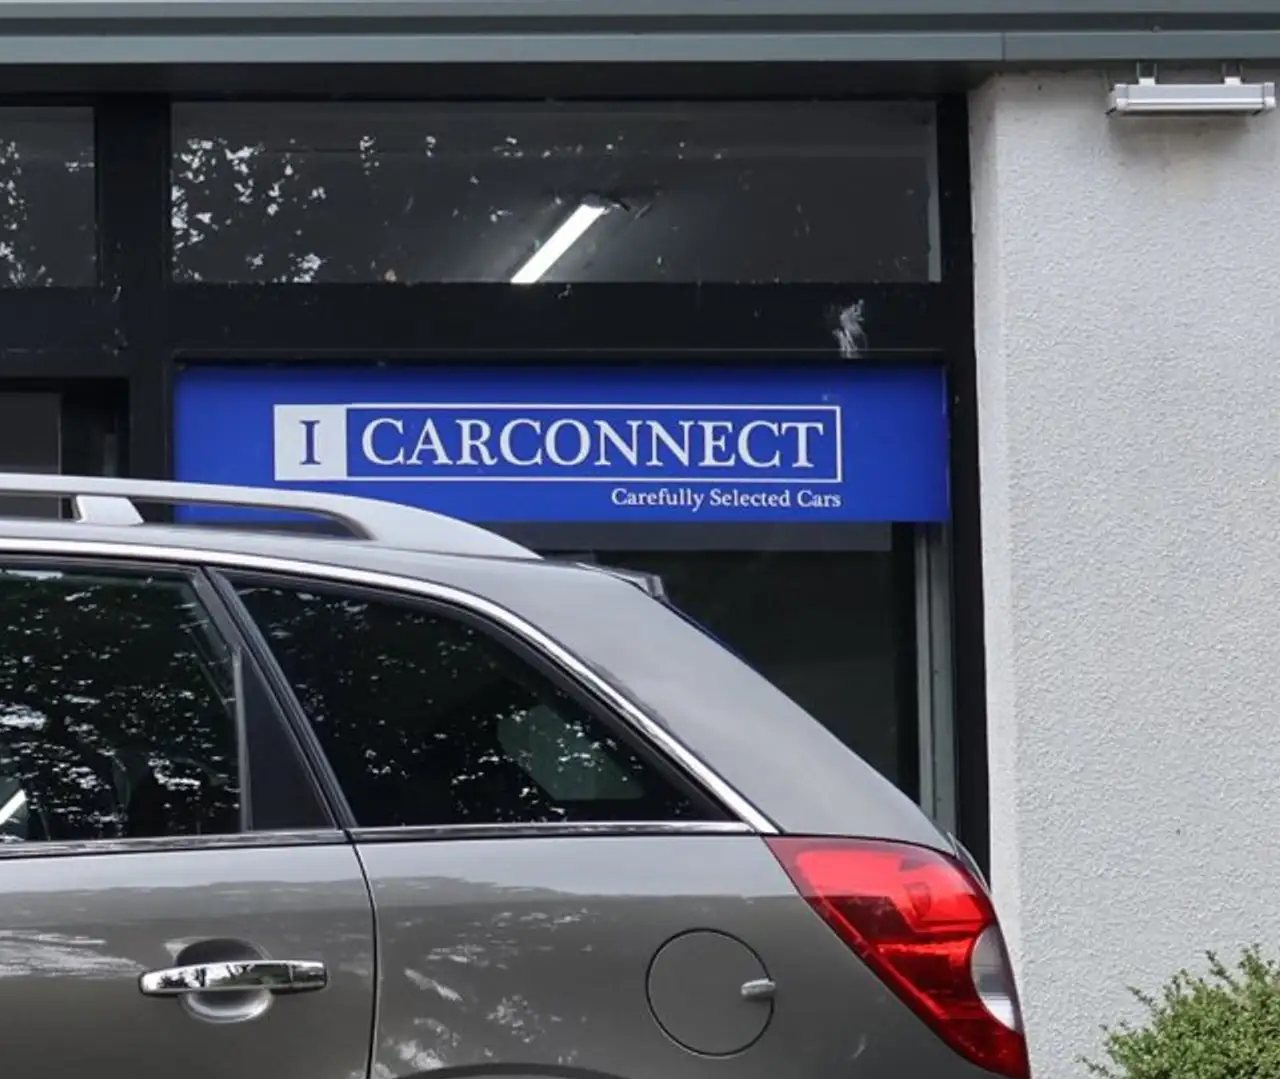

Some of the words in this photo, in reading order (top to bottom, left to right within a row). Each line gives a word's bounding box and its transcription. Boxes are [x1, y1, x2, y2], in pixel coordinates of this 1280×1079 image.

[361, 417, 824, 468] CARCONNECT
[611, 487, 705, 512] Carefully
[709, 488, 791, 508] Selected
[797, 489, 842, 509] Cars
